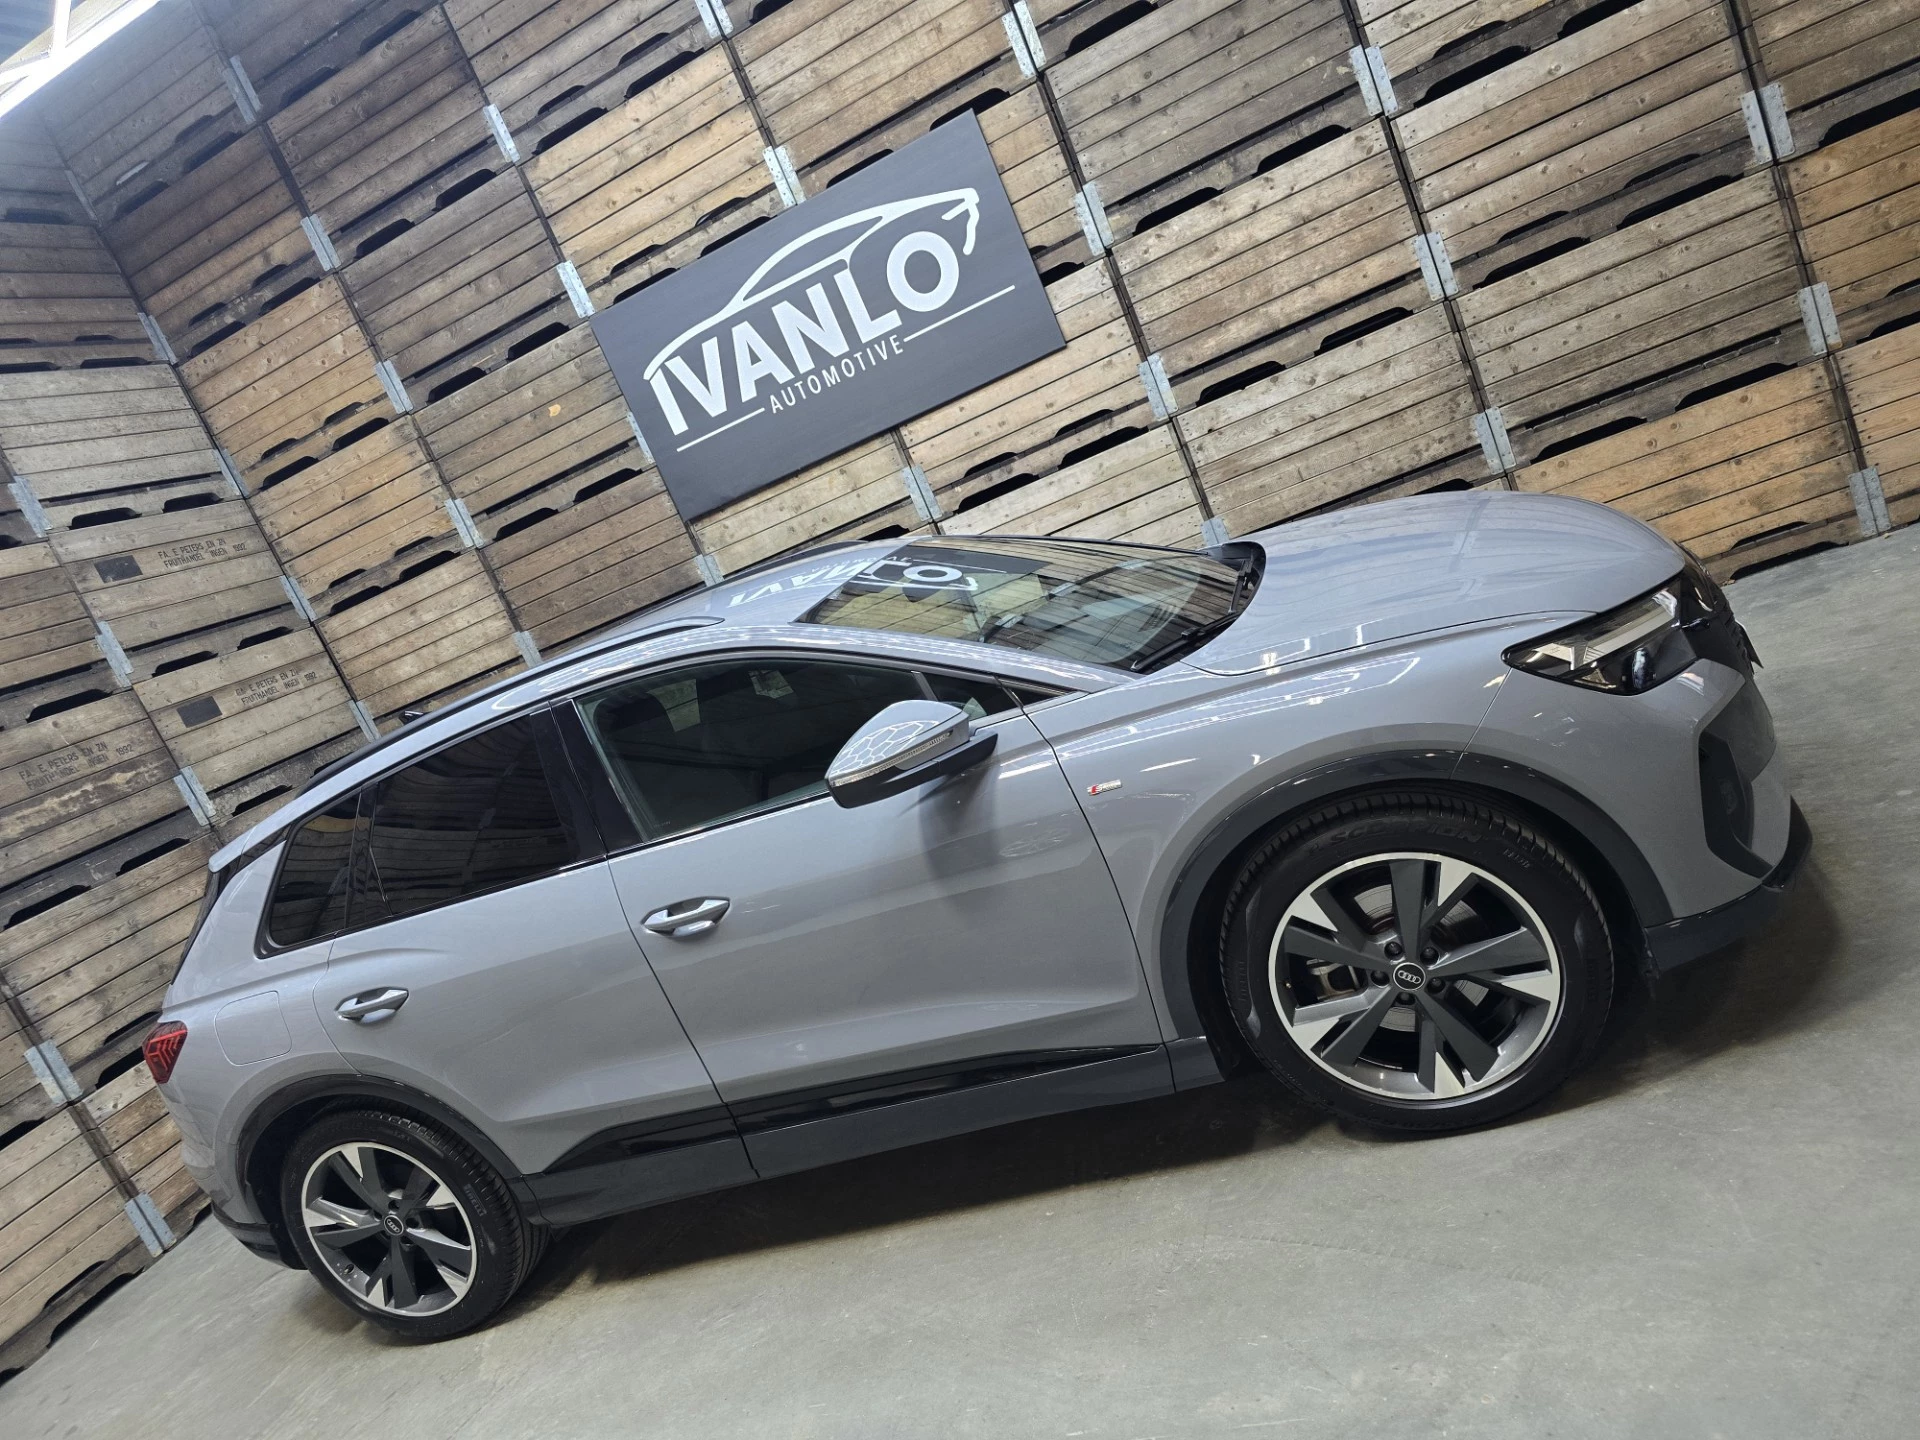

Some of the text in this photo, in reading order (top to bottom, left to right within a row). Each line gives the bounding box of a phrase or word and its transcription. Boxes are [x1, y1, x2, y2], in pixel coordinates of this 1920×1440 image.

[650, 231, 959, 435] IVANLO
[769, 334, 904, 414] AUTOMOTIVE
[163, 553, 205, 568] FRUITHANDEL
[232, 542, 247, 552] 1992
[180, 542, 204, 555] PETERS
[240, 686, 280, 706] FRUITHANDEL
[303, 670, 318, 681] 1992
[255, 675, 278, 690] PETERS
[47, 751, 79, 769] PETERS
[115, 743, 134, 756] 1992
